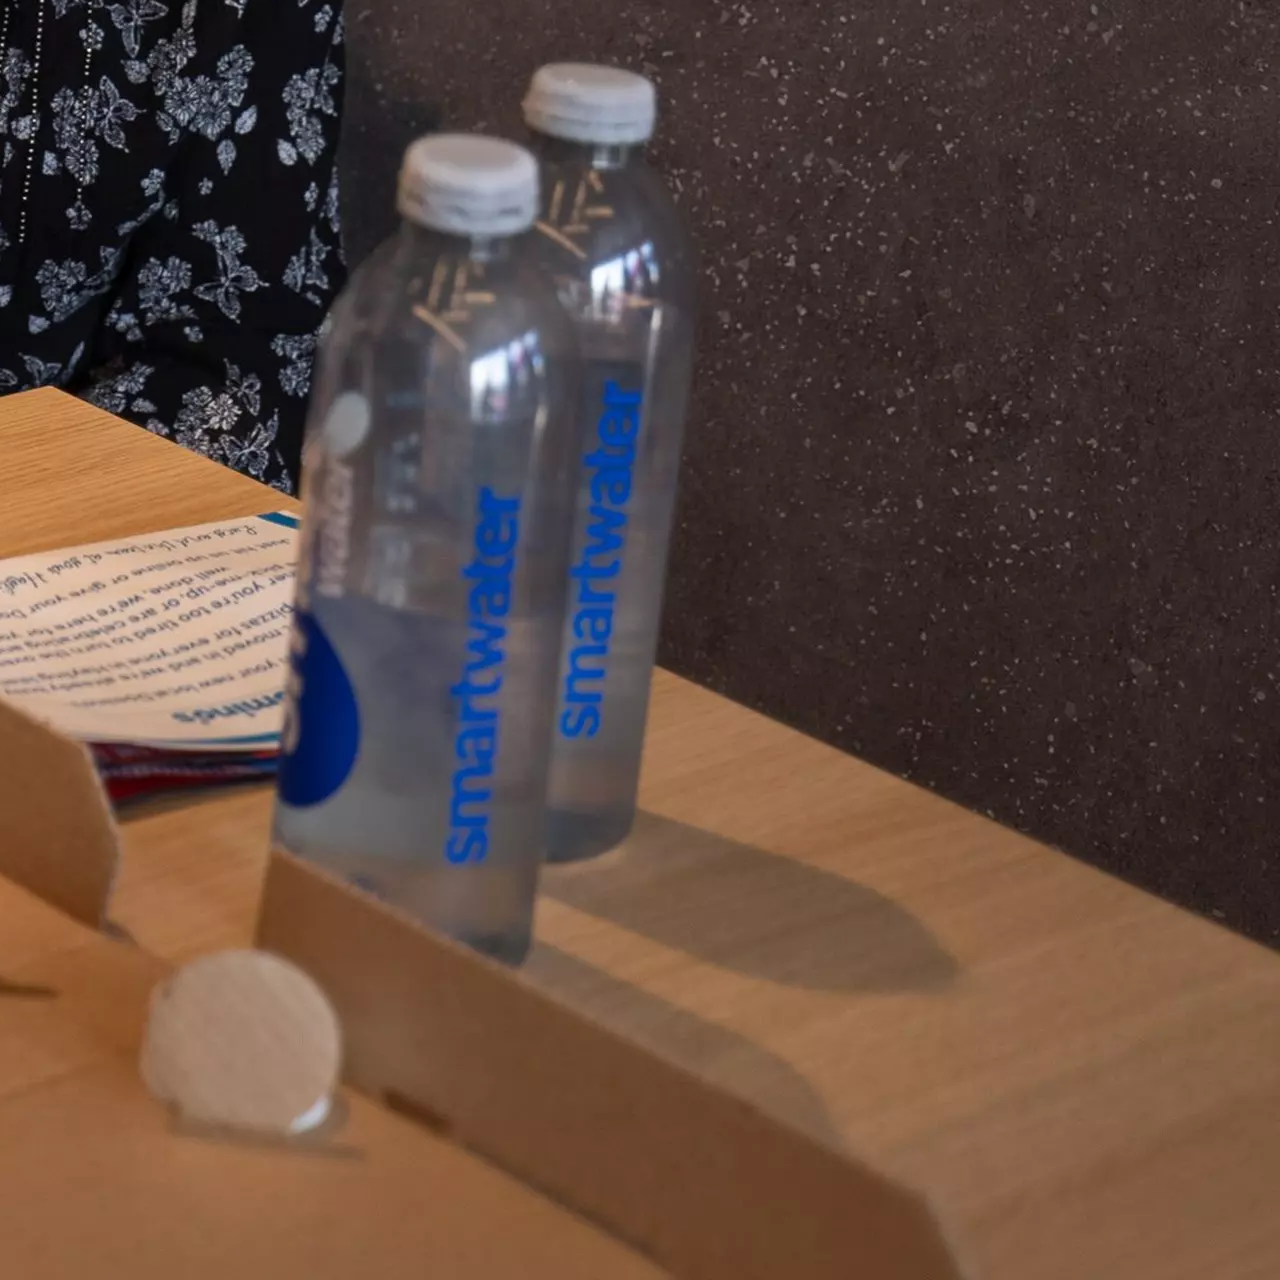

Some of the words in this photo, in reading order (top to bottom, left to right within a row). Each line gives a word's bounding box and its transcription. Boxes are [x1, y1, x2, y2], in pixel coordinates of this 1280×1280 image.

[131, 560, 184, 576] online
[560, 378, 642, 742] smartwater
[111, 574, 129, 584] or
[194, 567, 231, 581] well
[68, 581, 106, 598] give
[210, 580, 266, 606] you're
[28, 595, 68, 613] your
[96, 595, 145, 618] we're
[161, 598, 181, 611] or
[53, 614, 98, 632] here
[128, 608, 158, 623] are
[178, 606, 211, 623] too
[240, 602, 294, 630] pizzas
[24, 620, 127, 648] celebrating
[26, 628, 54, 637] for
[133, 620, 179, 640] tired
[214, 627, 242, 641] for
[111, 636, 134, 646] to
[222, 628, 281, 656] moved
[202, 650, 225, 661] in
[168, 657, 201, 673] and
[237, 658, 278, 679] your
[444, 485, 521, 866] smartwater
[171, 690, 285, 726] omino's
